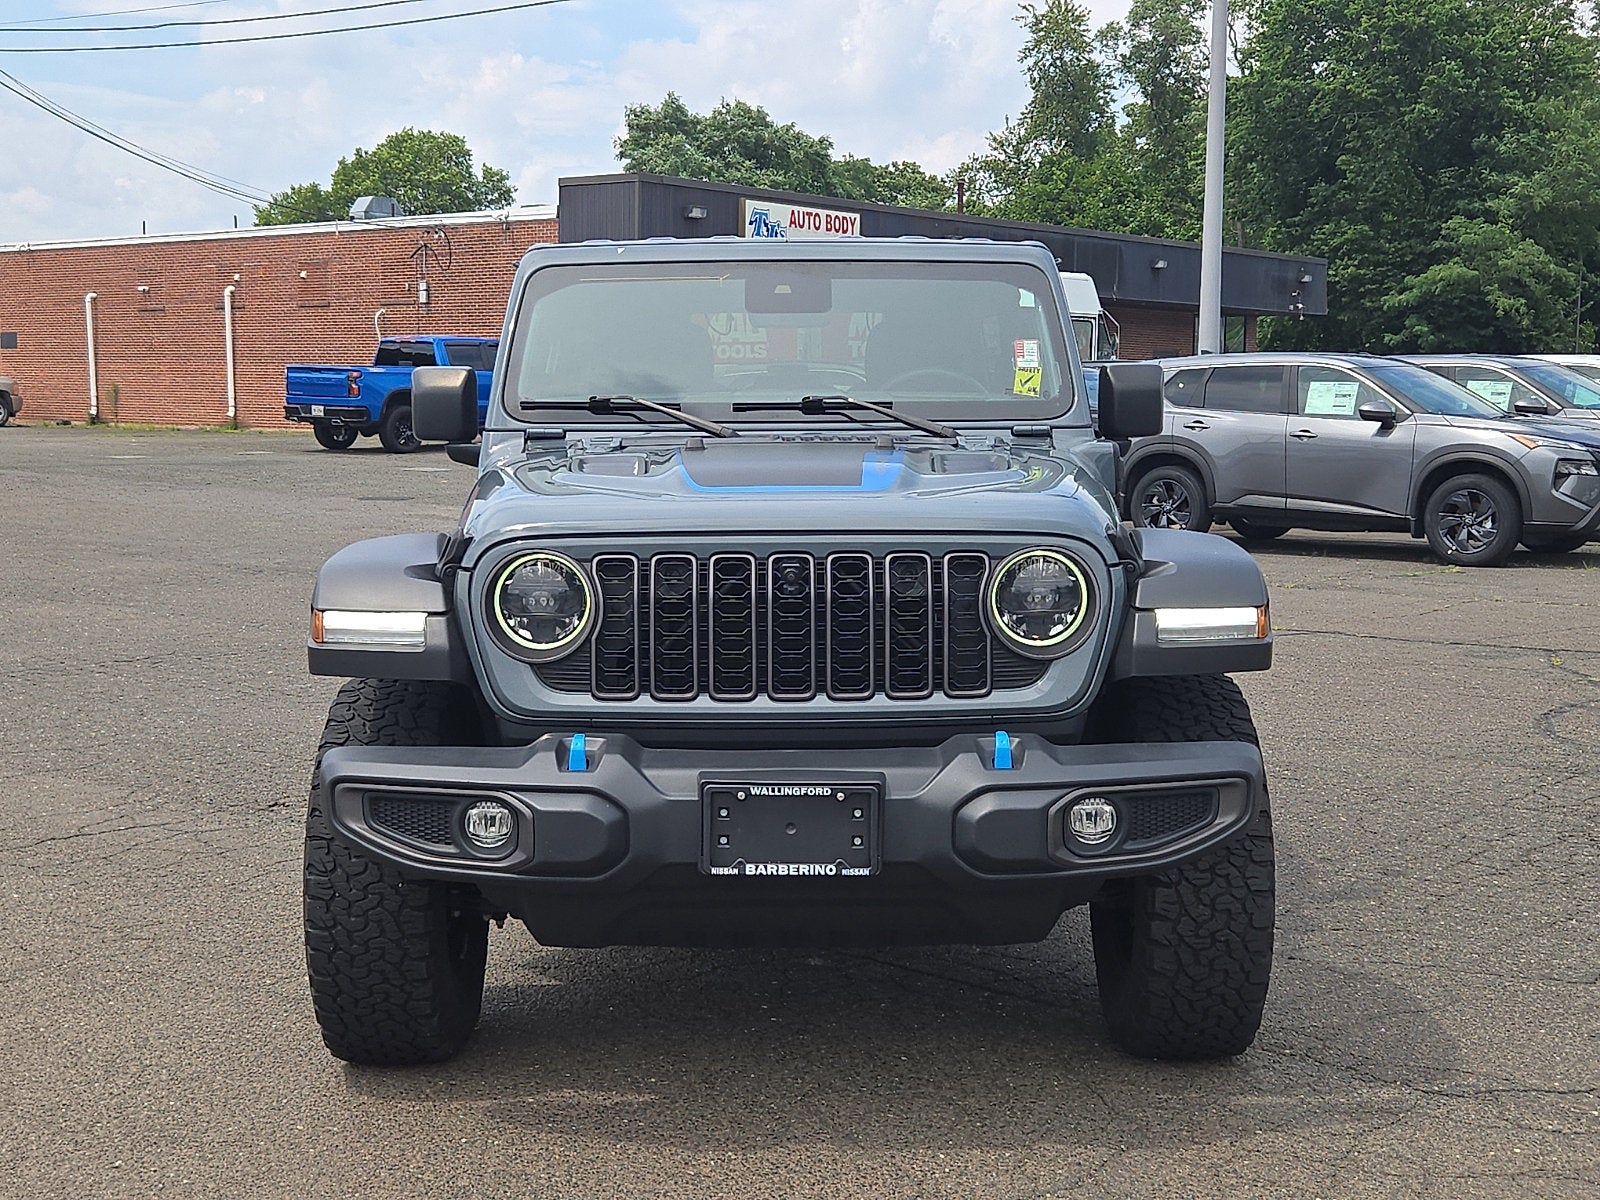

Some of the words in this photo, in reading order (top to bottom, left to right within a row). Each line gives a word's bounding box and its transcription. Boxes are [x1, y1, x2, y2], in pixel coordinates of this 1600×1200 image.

[789, 209, 821, 231] AUTO
[825, 214, 857, 235] BODY
[749, 786, 832, 796] WALLINGFORD
[711, 867, 739, 875] NISSAN
[745, 864, 837, 876] BARBERINO
[841, 868, 870, 876] NISSAN
